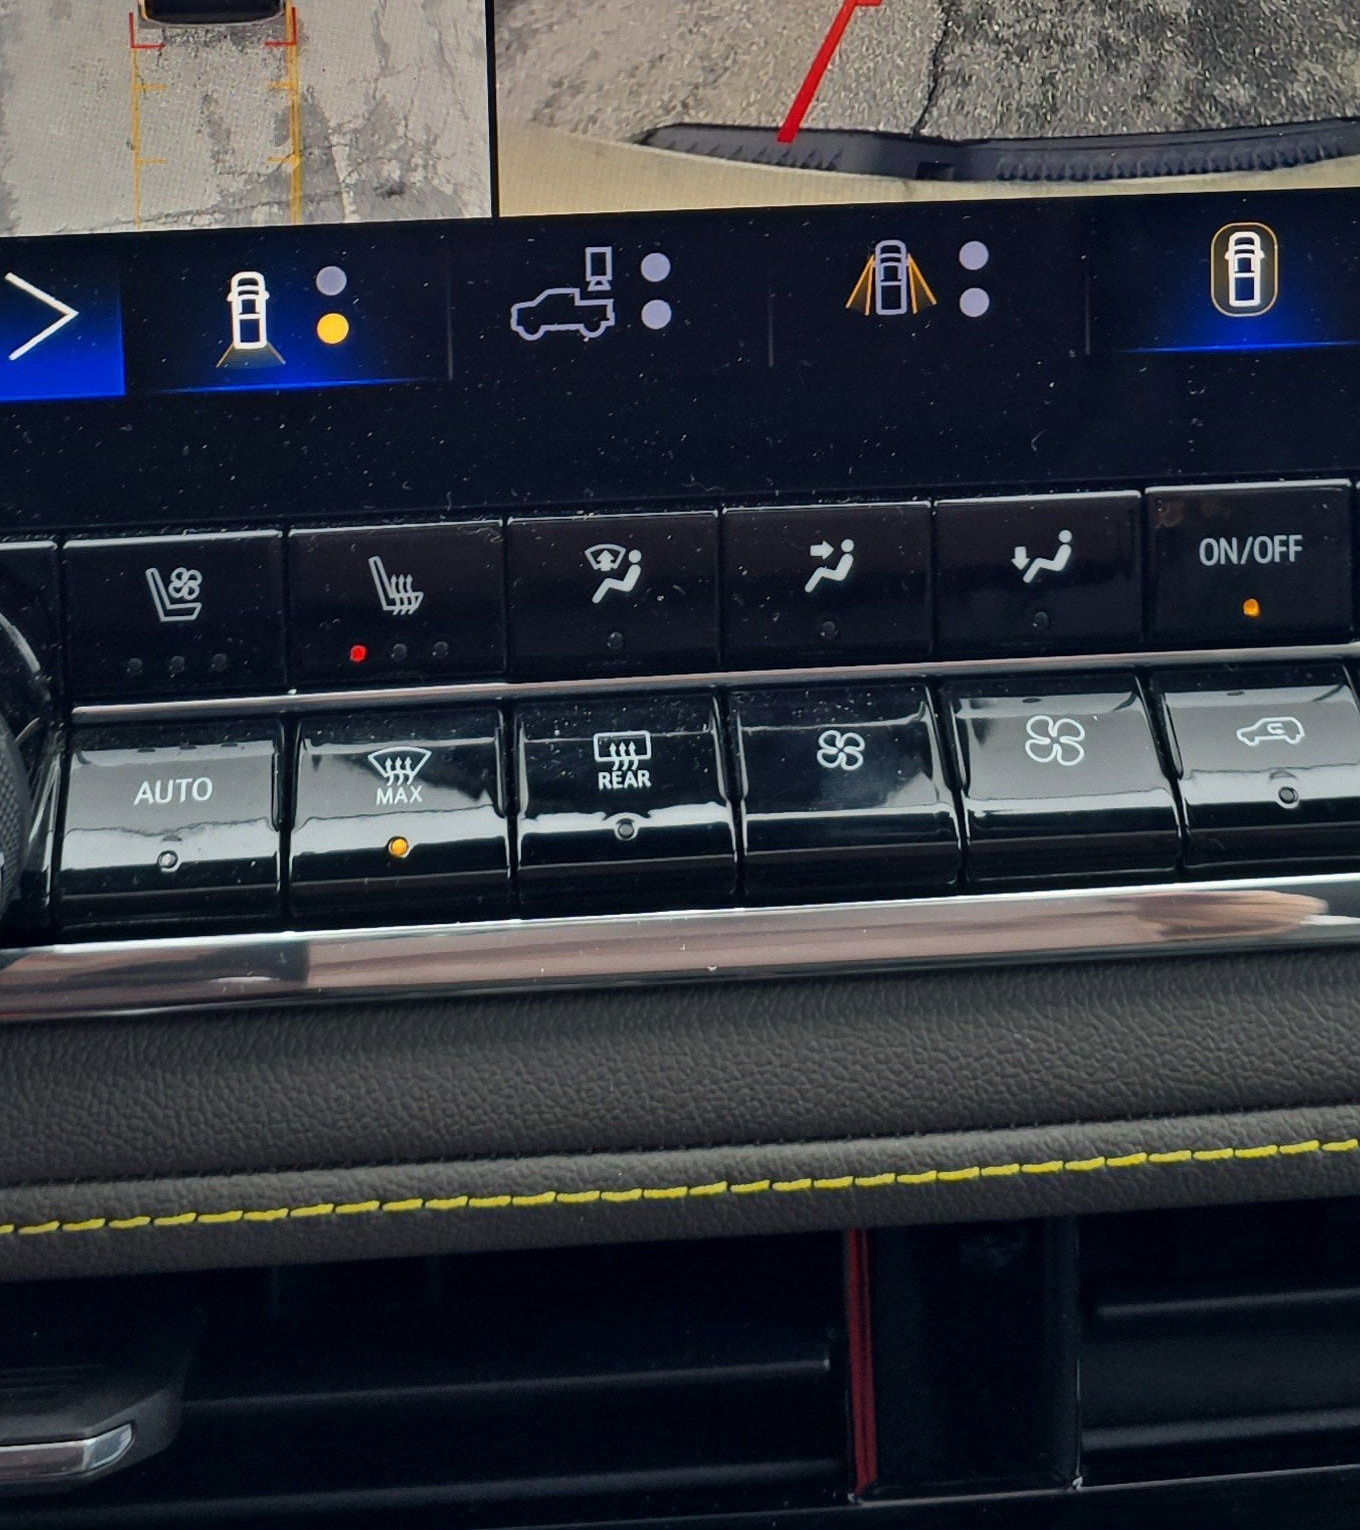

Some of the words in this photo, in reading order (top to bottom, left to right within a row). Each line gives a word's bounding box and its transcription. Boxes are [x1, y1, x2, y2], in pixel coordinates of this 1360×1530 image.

[1198, 533, 1304, 567] ON/OFF
[133, 776, 215, 806] AUTO
[598, 768, 653, 791] REAR
[375, 785, 424, 806] MAX
